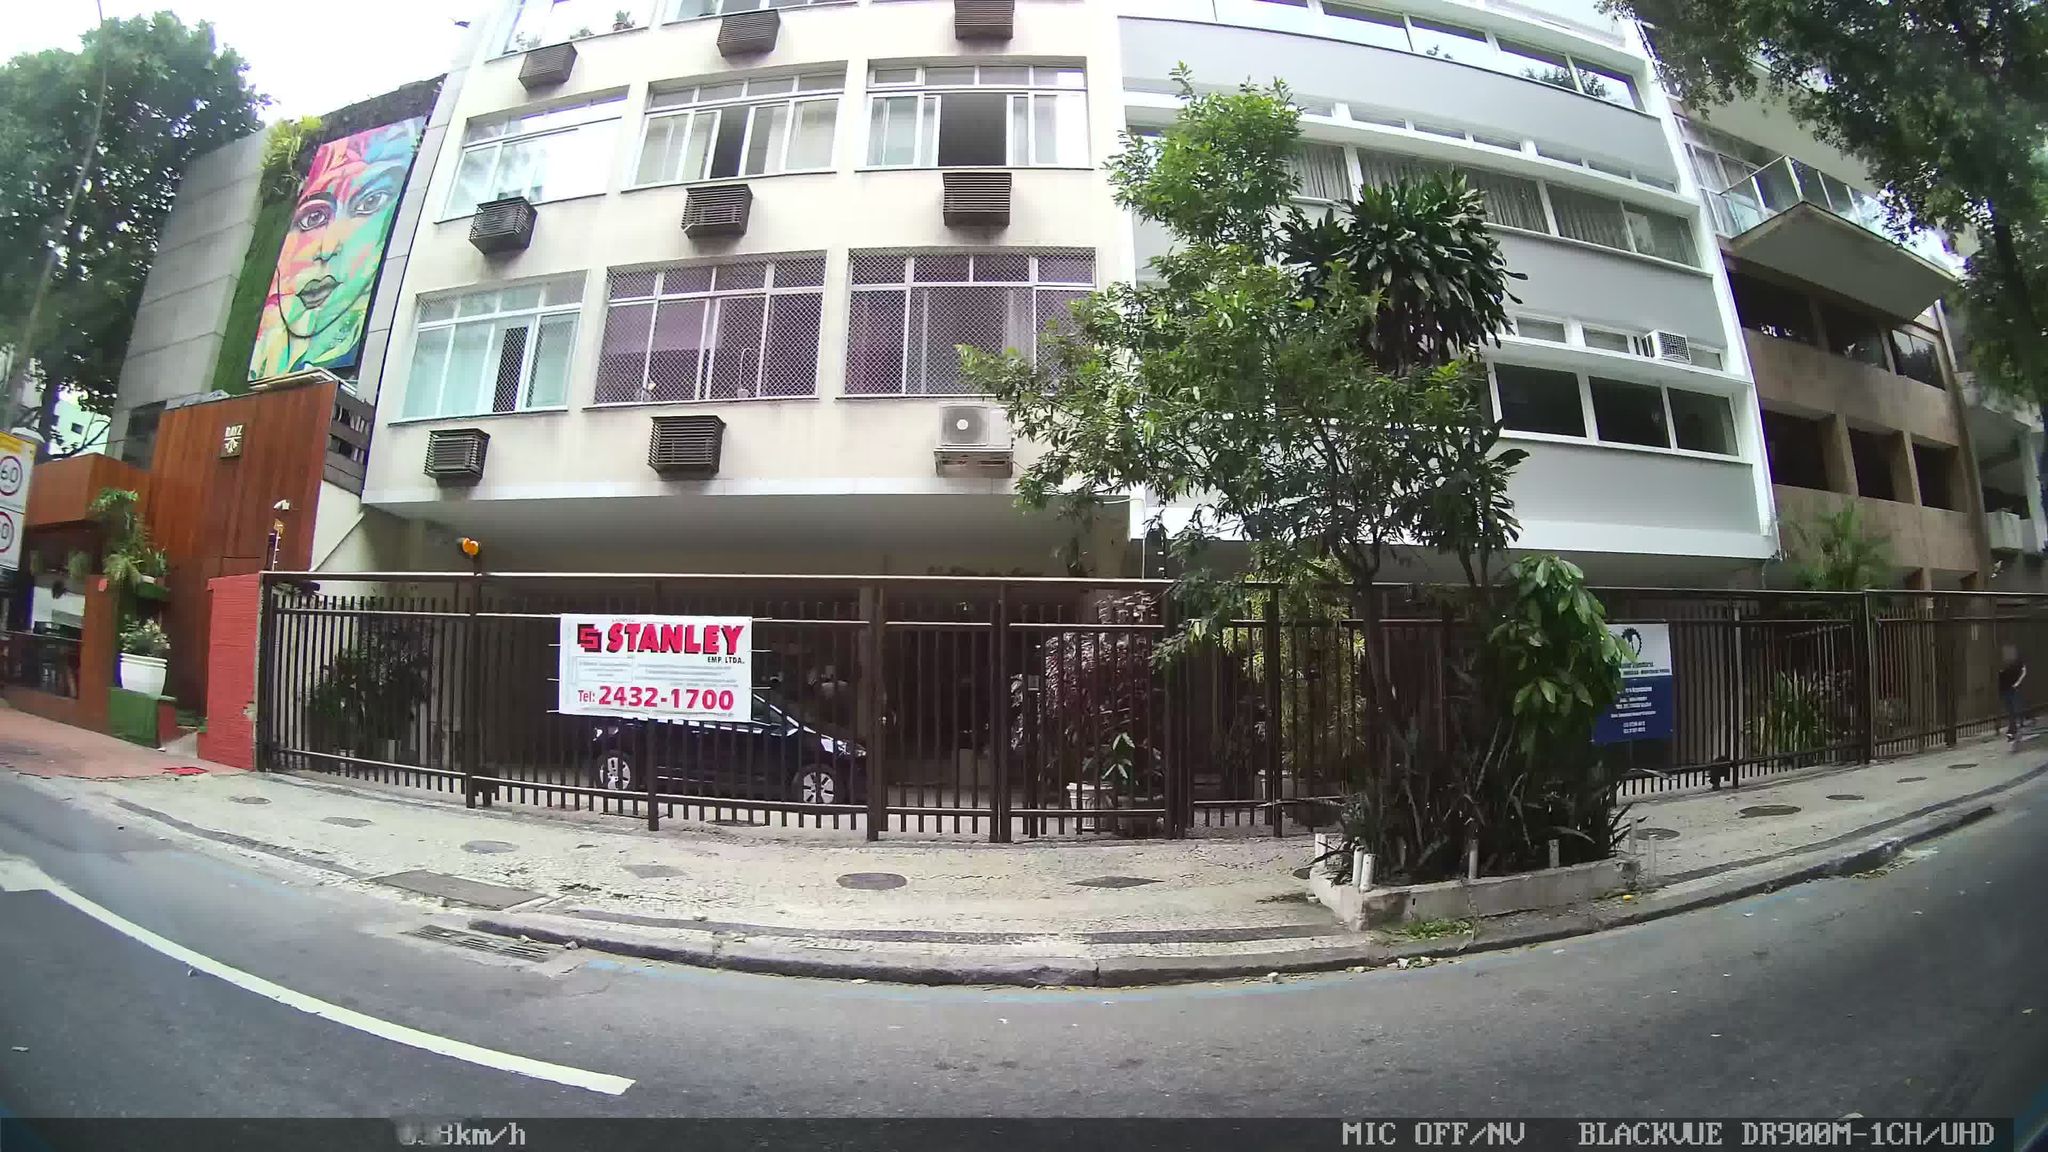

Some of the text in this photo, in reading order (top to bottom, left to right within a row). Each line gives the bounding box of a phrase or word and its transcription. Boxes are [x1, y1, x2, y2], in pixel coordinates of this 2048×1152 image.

[606, 622, 745, 655] STANLEY
[577, 685, 735, 711] Tel: 2432-1700
